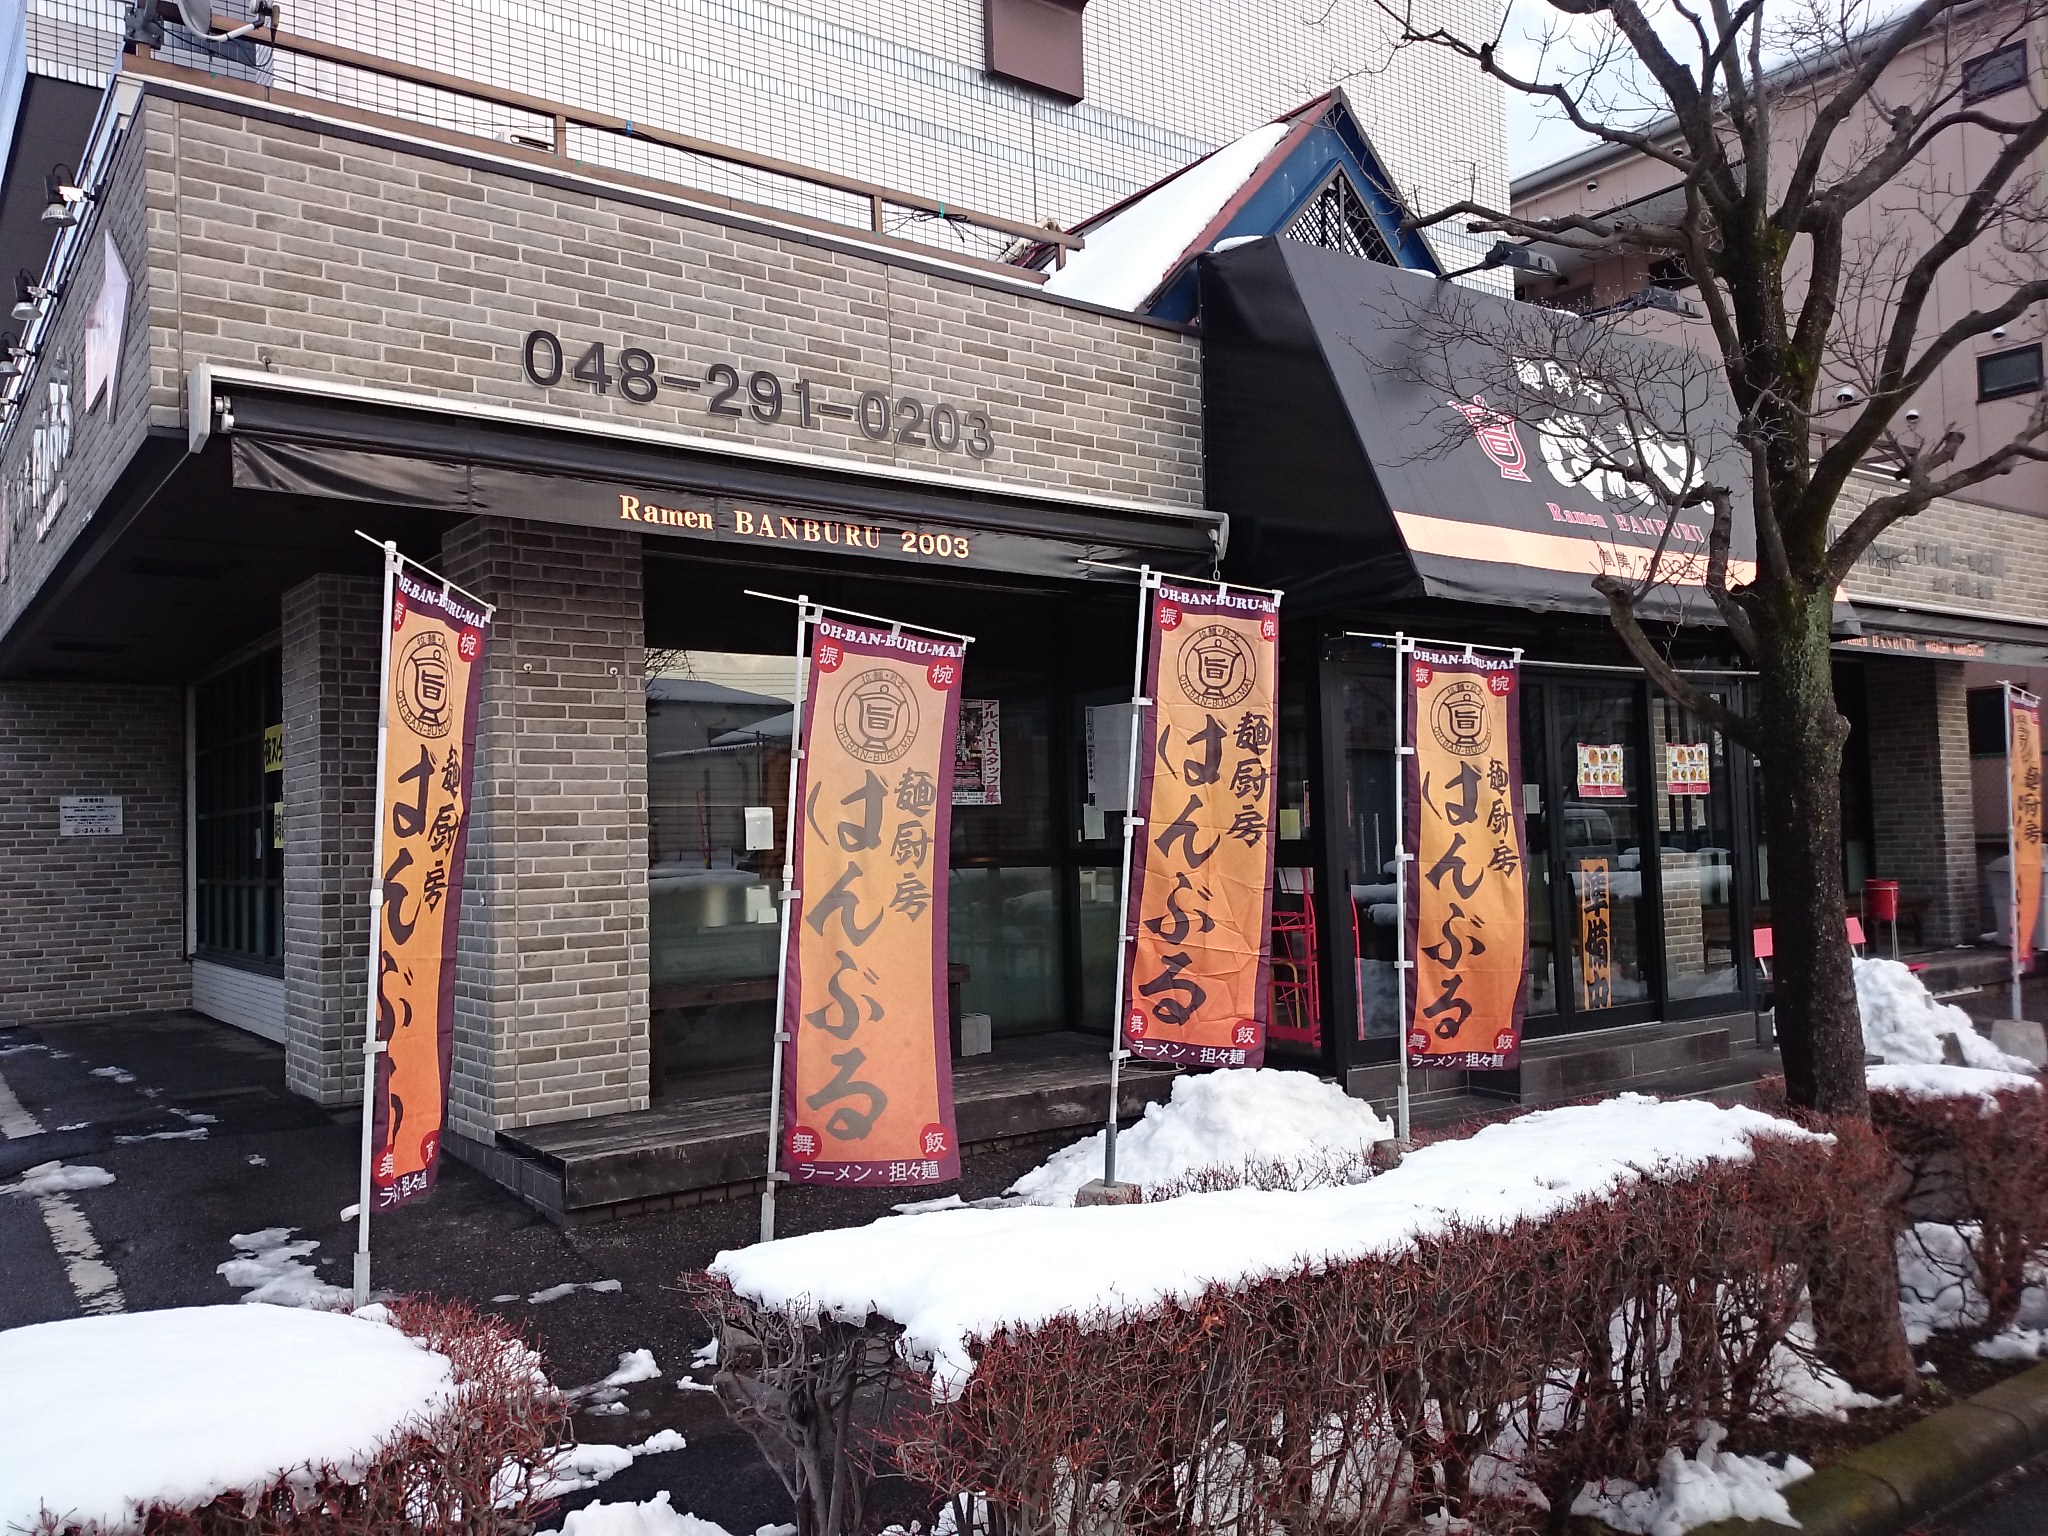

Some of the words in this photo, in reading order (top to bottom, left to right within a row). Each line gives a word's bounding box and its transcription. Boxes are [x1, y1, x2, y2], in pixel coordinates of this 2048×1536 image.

[523, 330, 995, 459] 048-291-0203
[620, 495, 713, 531] Ramen
[734, 510, 880, 549] BANBURU
[902, 531, 970, 560] 2003
[1546, 502, 1608, 529] Ramen
[1158, 587, 1276, 614] OH-BAN-BURU-MAI
[1160, 606, 1178, 626] 振
[819, 622, 965, 658] OH-BAN-BURU-MAI
[818, 644, 838, 667] 振
[1415, 667, 1429, 684] 振
[1227, 710, 1272, 848] 麺厨房
[889, 766, 937, 923] 麺厨房
[1138, 713, 1228, 1027] ばんぶる
[1421, 760, 1487, 1040] ばんぶる
[1584, 864, 1611, 1010] 準備中
[804, 769, 890, 1141] ばんぶる
[1235, 1026, 1256, 1044] 飯
[1496, 1033, 1514, 1051] 飯
[1133, 1039, 1246, 1065] ラーメン・担々麺
[1411, 1052, 1506, 1069] ラーメン・担々麺
[792, 1133, 816, 1156] 舞
[925, 1131, 947, 1153] 飯
[798, 1159, 940, 1182] ラーメン・担々麺
